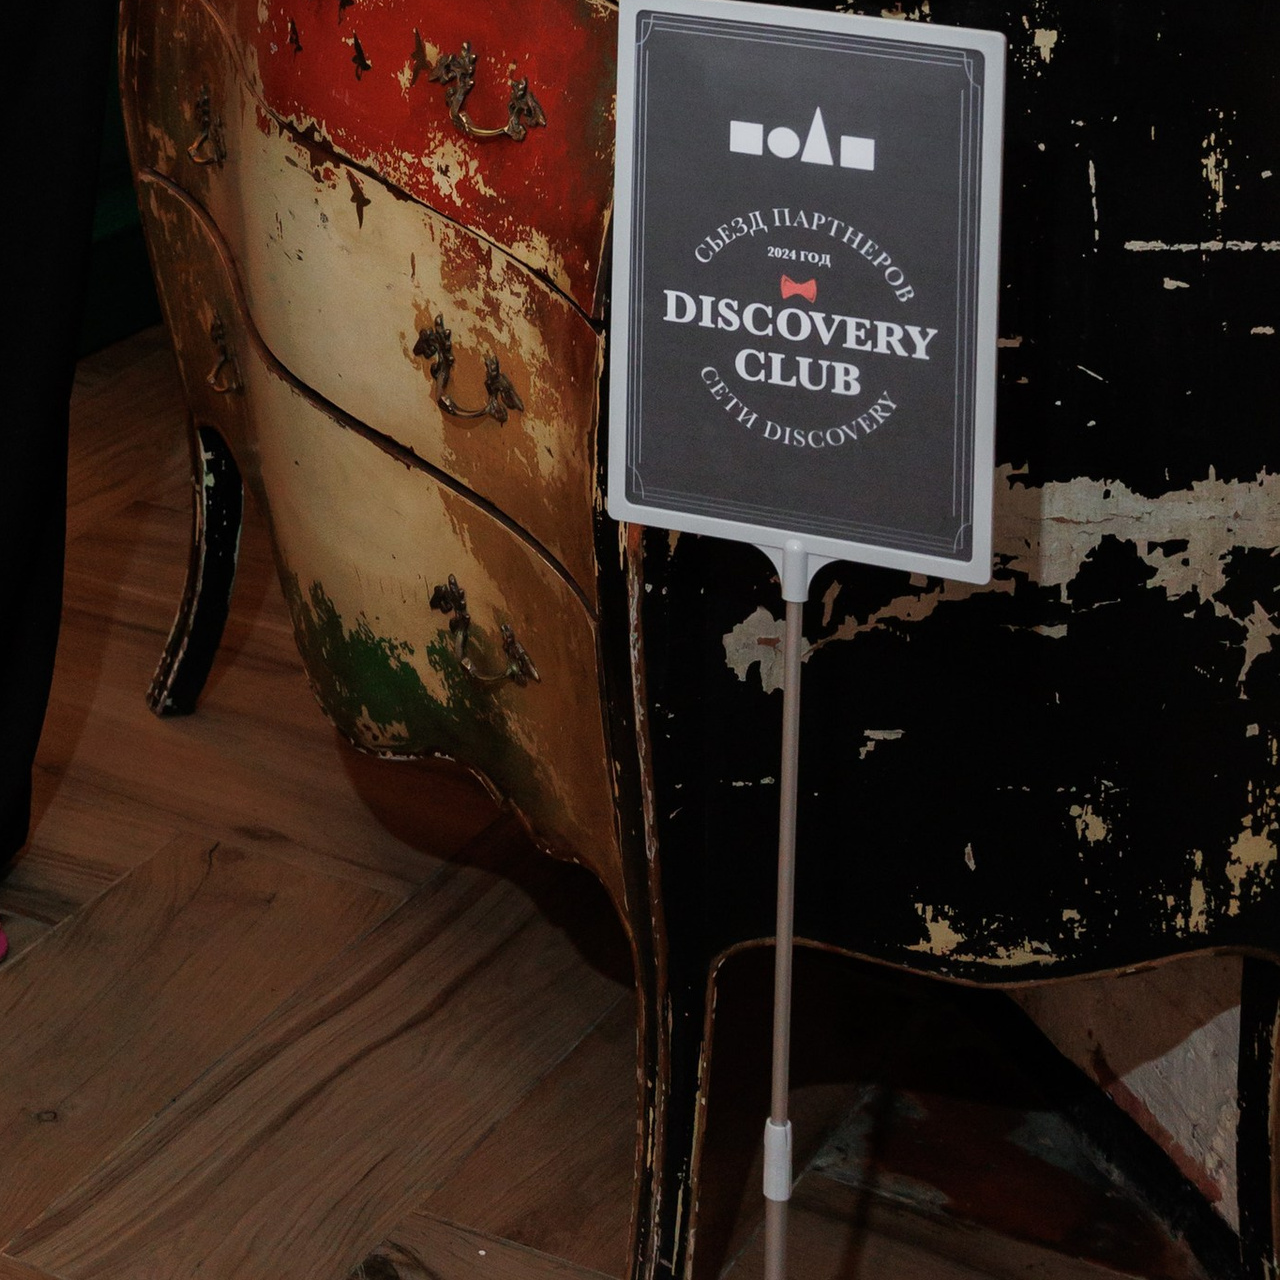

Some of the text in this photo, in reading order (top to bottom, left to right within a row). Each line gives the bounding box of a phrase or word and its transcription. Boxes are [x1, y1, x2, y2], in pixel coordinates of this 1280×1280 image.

[767, 246, 797, 260] 2024
[772, 208, 915, 302] ПАРТНЕРОВ
[663, 289, 938, 360] DISCOVERY
[701, 366, 898, 449] СЕТИ DISCOVERY
[734, 348, 861, 396] CLUB
